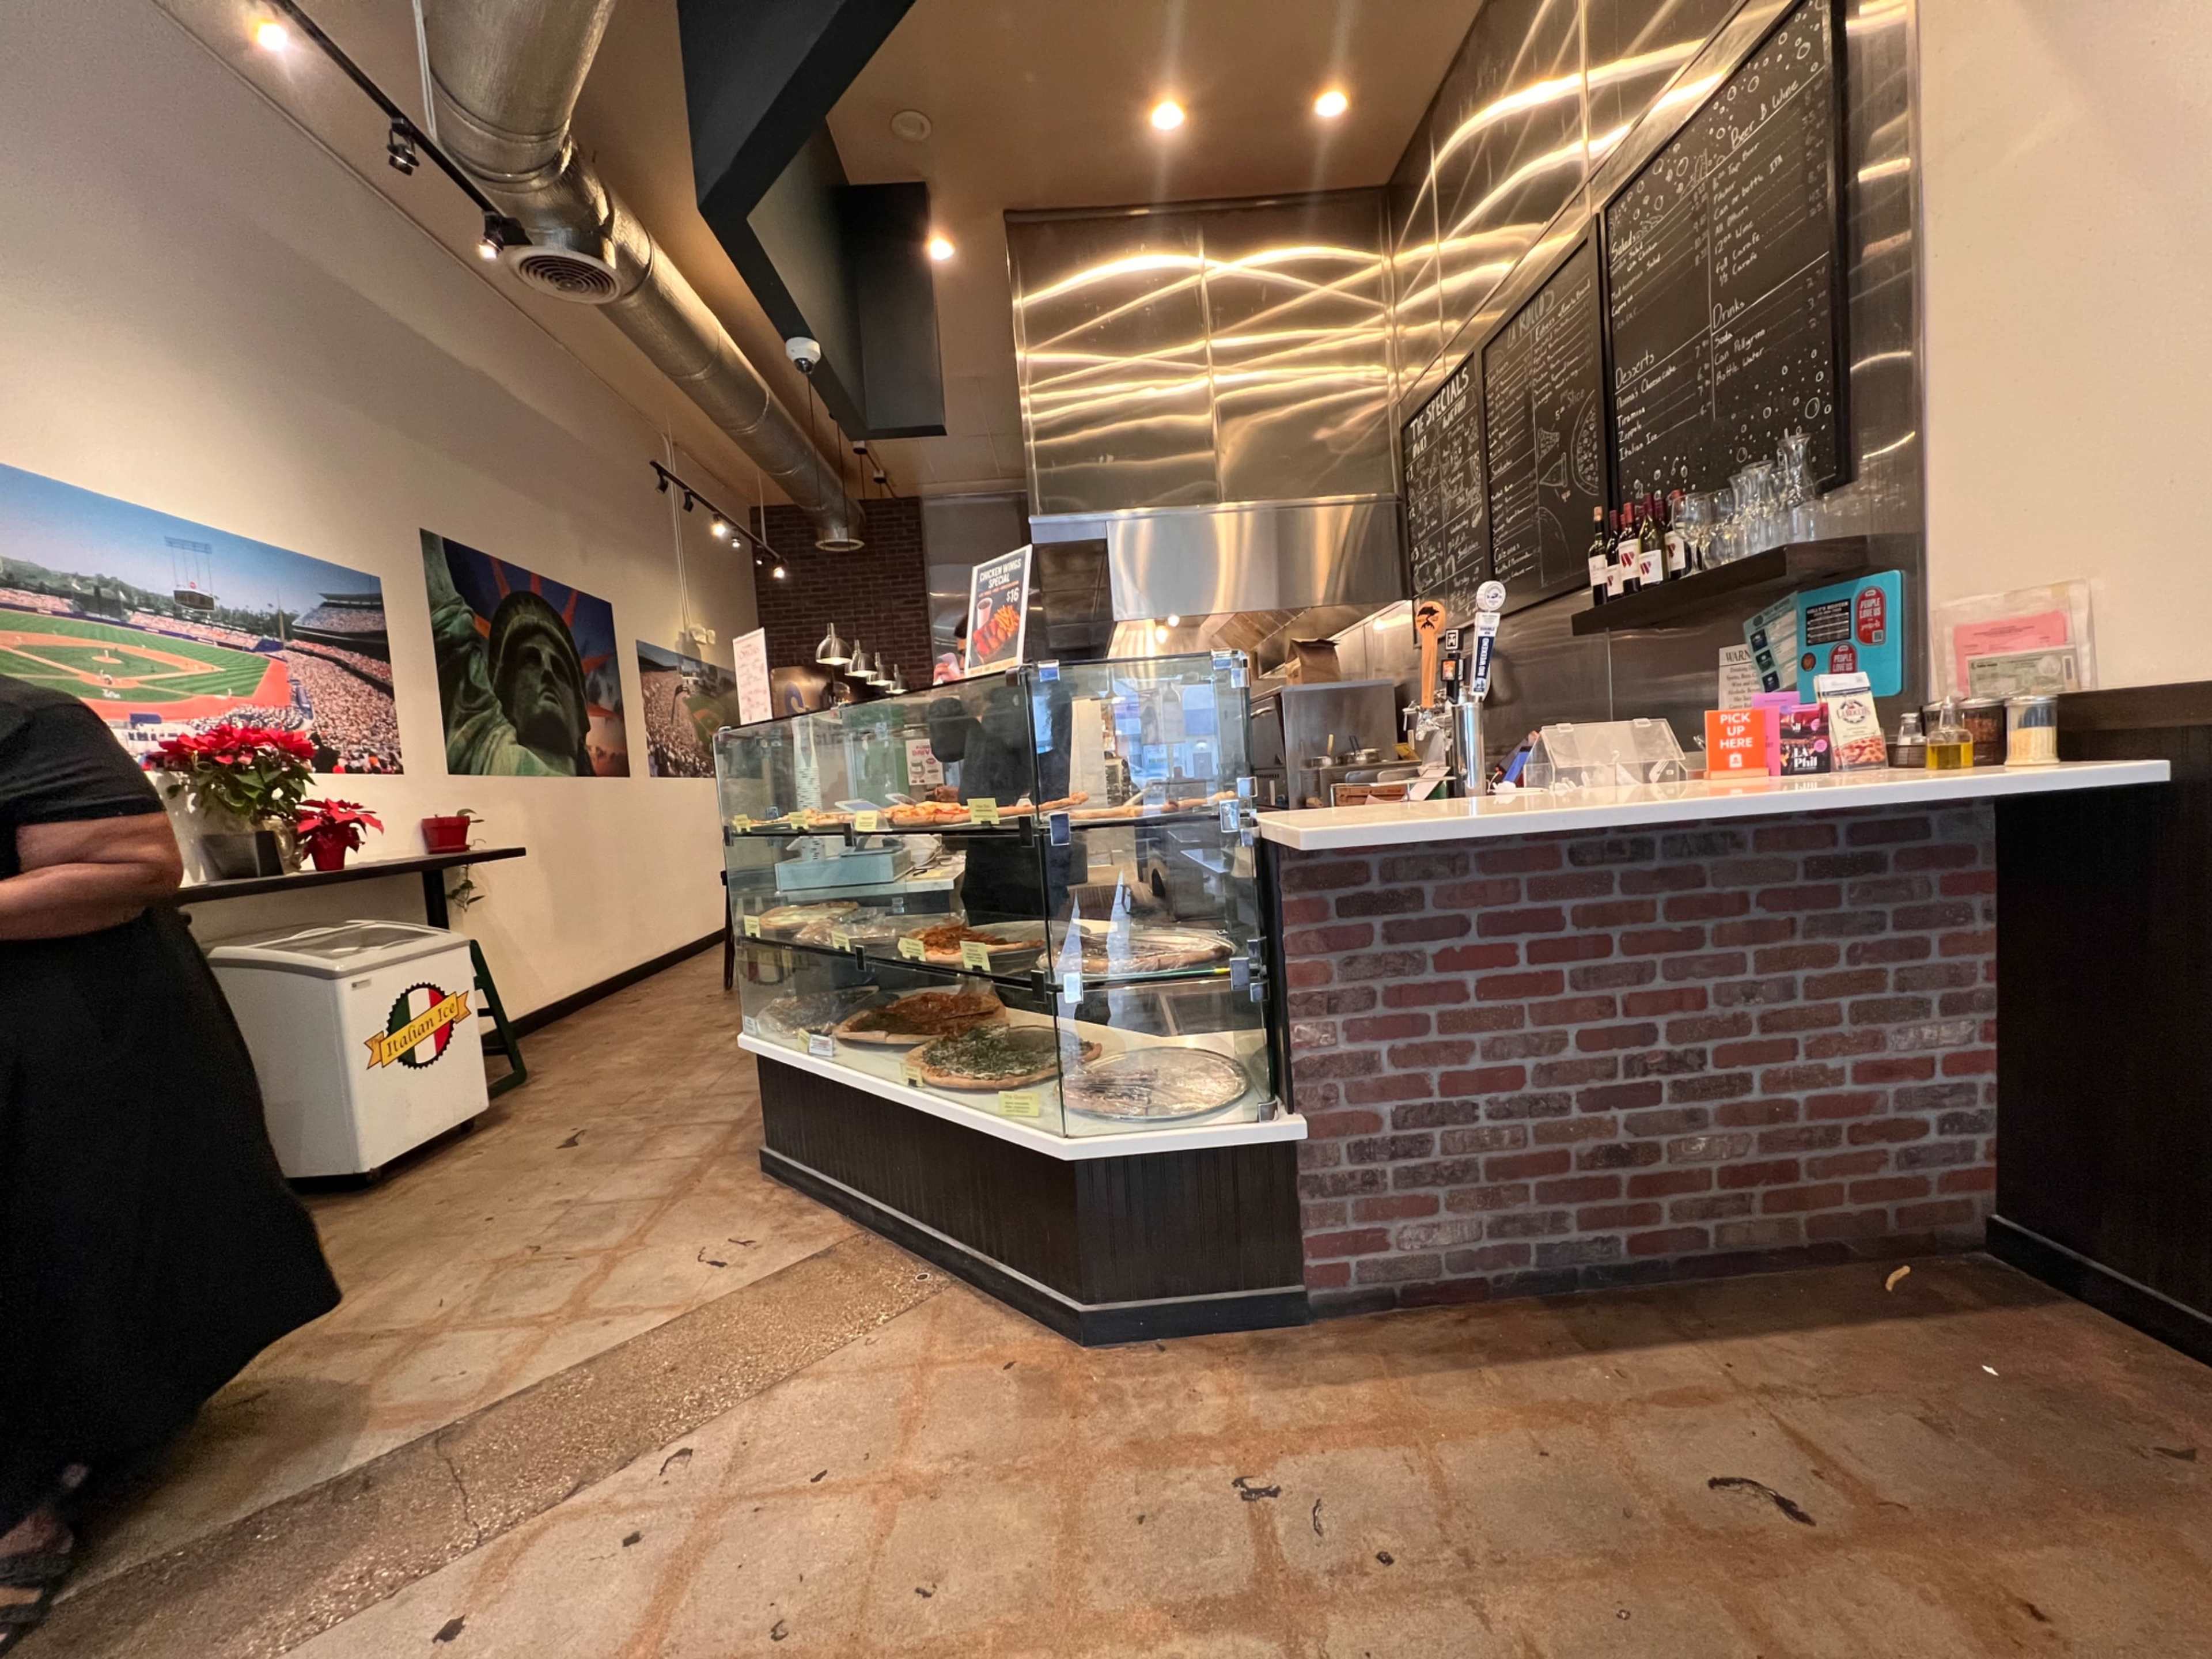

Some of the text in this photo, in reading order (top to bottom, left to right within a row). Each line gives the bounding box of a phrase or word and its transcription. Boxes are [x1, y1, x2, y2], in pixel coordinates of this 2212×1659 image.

[1731, 120, 1755, 149] Beer
[1772, 80, 1798, 108] Wine
[1714, 205, 1728, 221] Can
[1713, 298, 1745, 328] Drinks
[1715, 351, 1729, 365] Can
[1616, 349, 1654, 389] Desserts
[1426, 367, 1468, 426] SPECIALS
[979, 558, 1022, 582] CHICKEN WINGS
[988, 573, 1010, 588] SPECIAL
[1006, 587, 1020, 603] $16
[1860, 598, 1881, 609] PEOPLE
[1859, 607, 1881, 618] LOVE US
[1726, 650, 1751, 662] WARN
[1834, 653, 1853, 663] PEOPLE
[1833, 662, 1853, 672] LOVE US
[1720, 713, 1751, 725] PICK
[1726, 725, 1745, 736] UP
[1720, 737, 1753, 749] HERE
[1794, 747, 1808, 757] LA
[1794, 756, 1817, 768] Phil
[387, 1002, 454, 1057] Italian Ice
